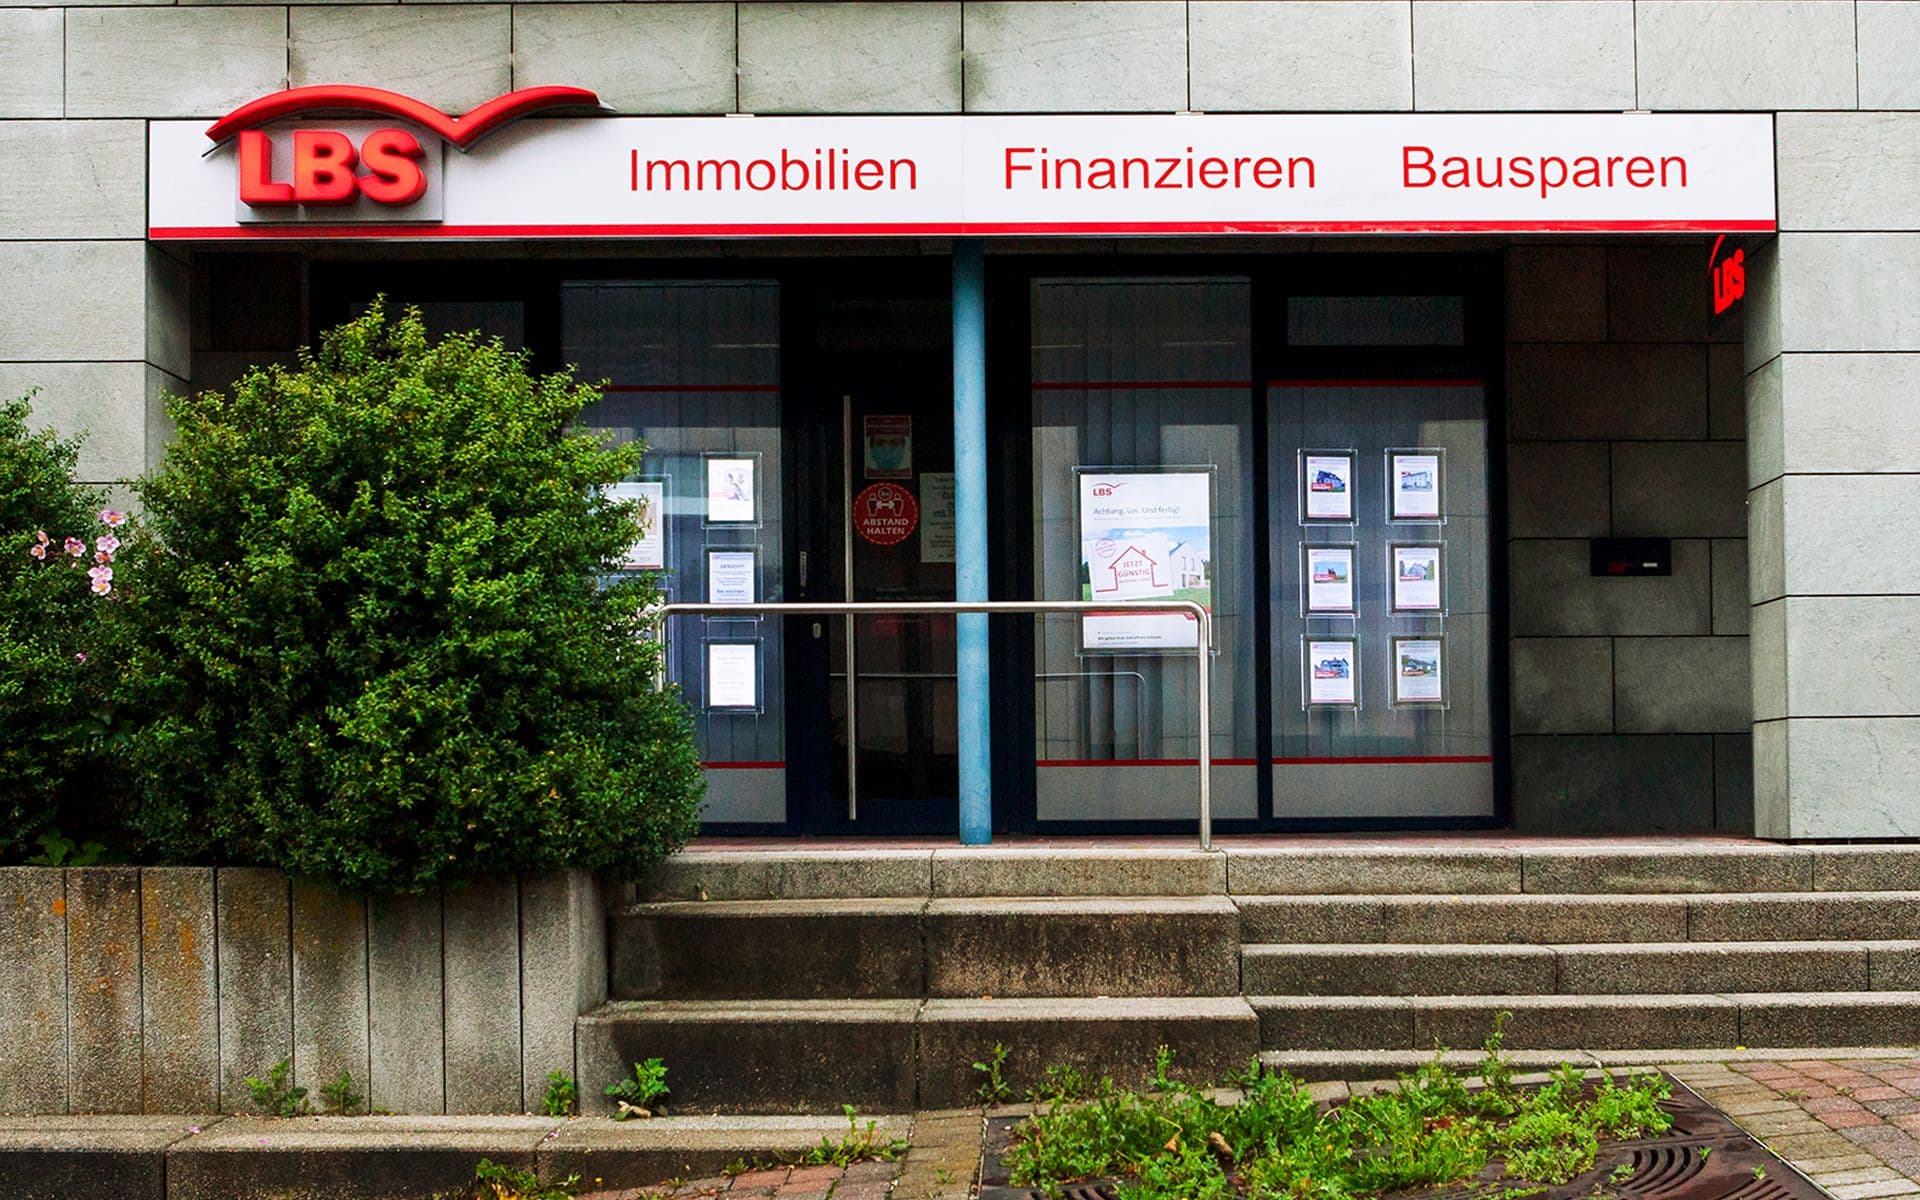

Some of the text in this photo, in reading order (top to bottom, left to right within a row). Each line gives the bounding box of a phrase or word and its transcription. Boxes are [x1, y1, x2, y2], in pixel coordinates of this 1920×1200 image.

[239, 128, 428, 208] LBS
[630, 145, 1688, 200] Immobilien Finanzieren Bausparen
[1713, 248, 1745, 315] LBS
[1093, 488, 1112, 496] LBS
[1142, 506, 1157, 514] Und
[863, 518, 909, 526] ABSTAND
[867, 527, 905, 535] HALTEN
[1123, 560, 1143, 568] JETZT
[1117, 568, 1151, 578] GÜNSTIG
